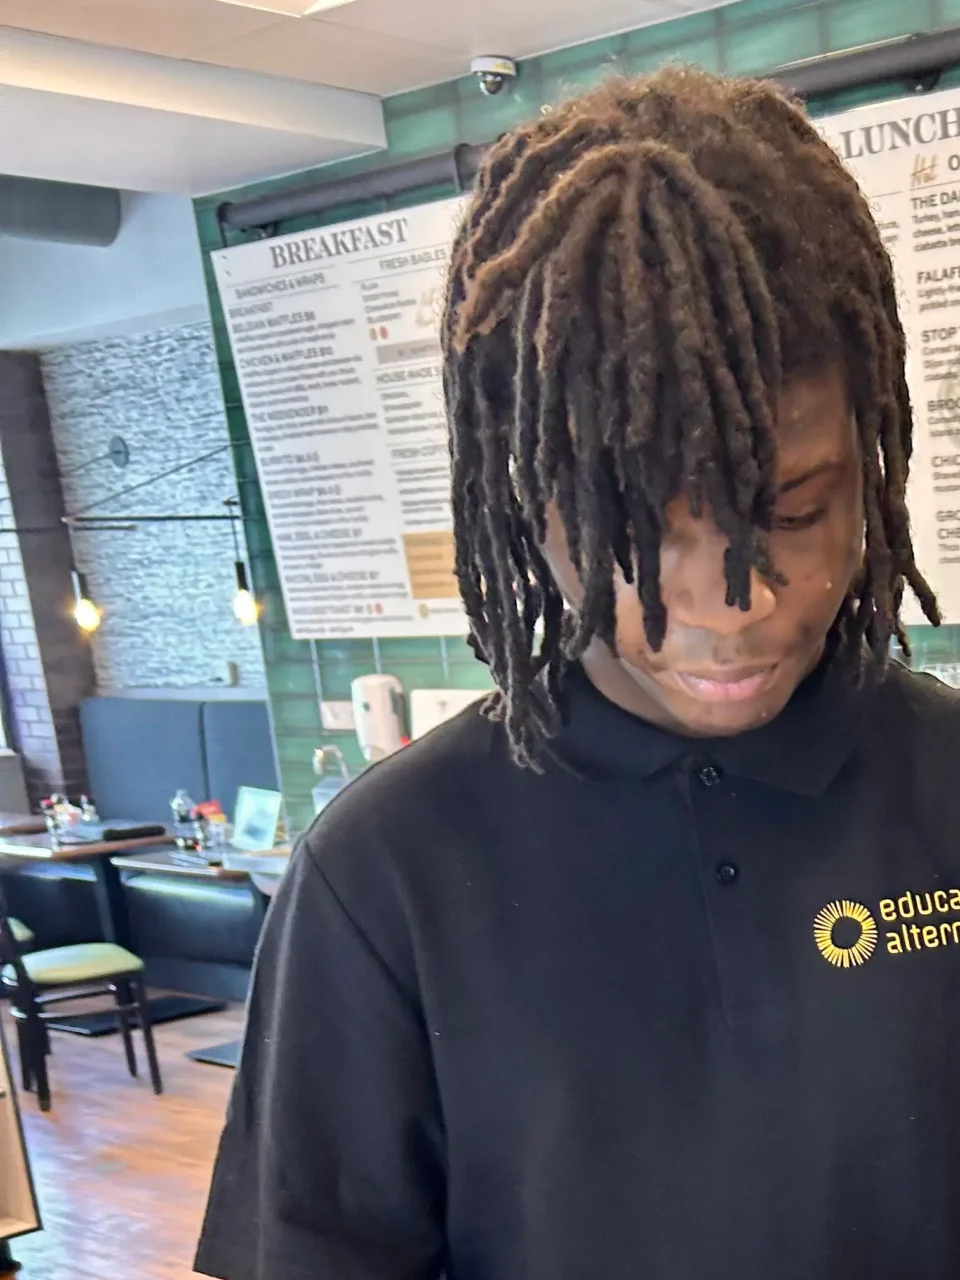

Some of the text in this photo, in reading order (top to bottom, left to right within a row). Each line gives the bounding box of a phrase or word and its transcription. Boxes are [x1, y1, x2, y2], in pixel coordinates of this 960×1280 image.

[911, 194, 937, 210] THE
[269, 217, 408, 269] BREAKFAST
[921, 327, 956, 343] STOP
